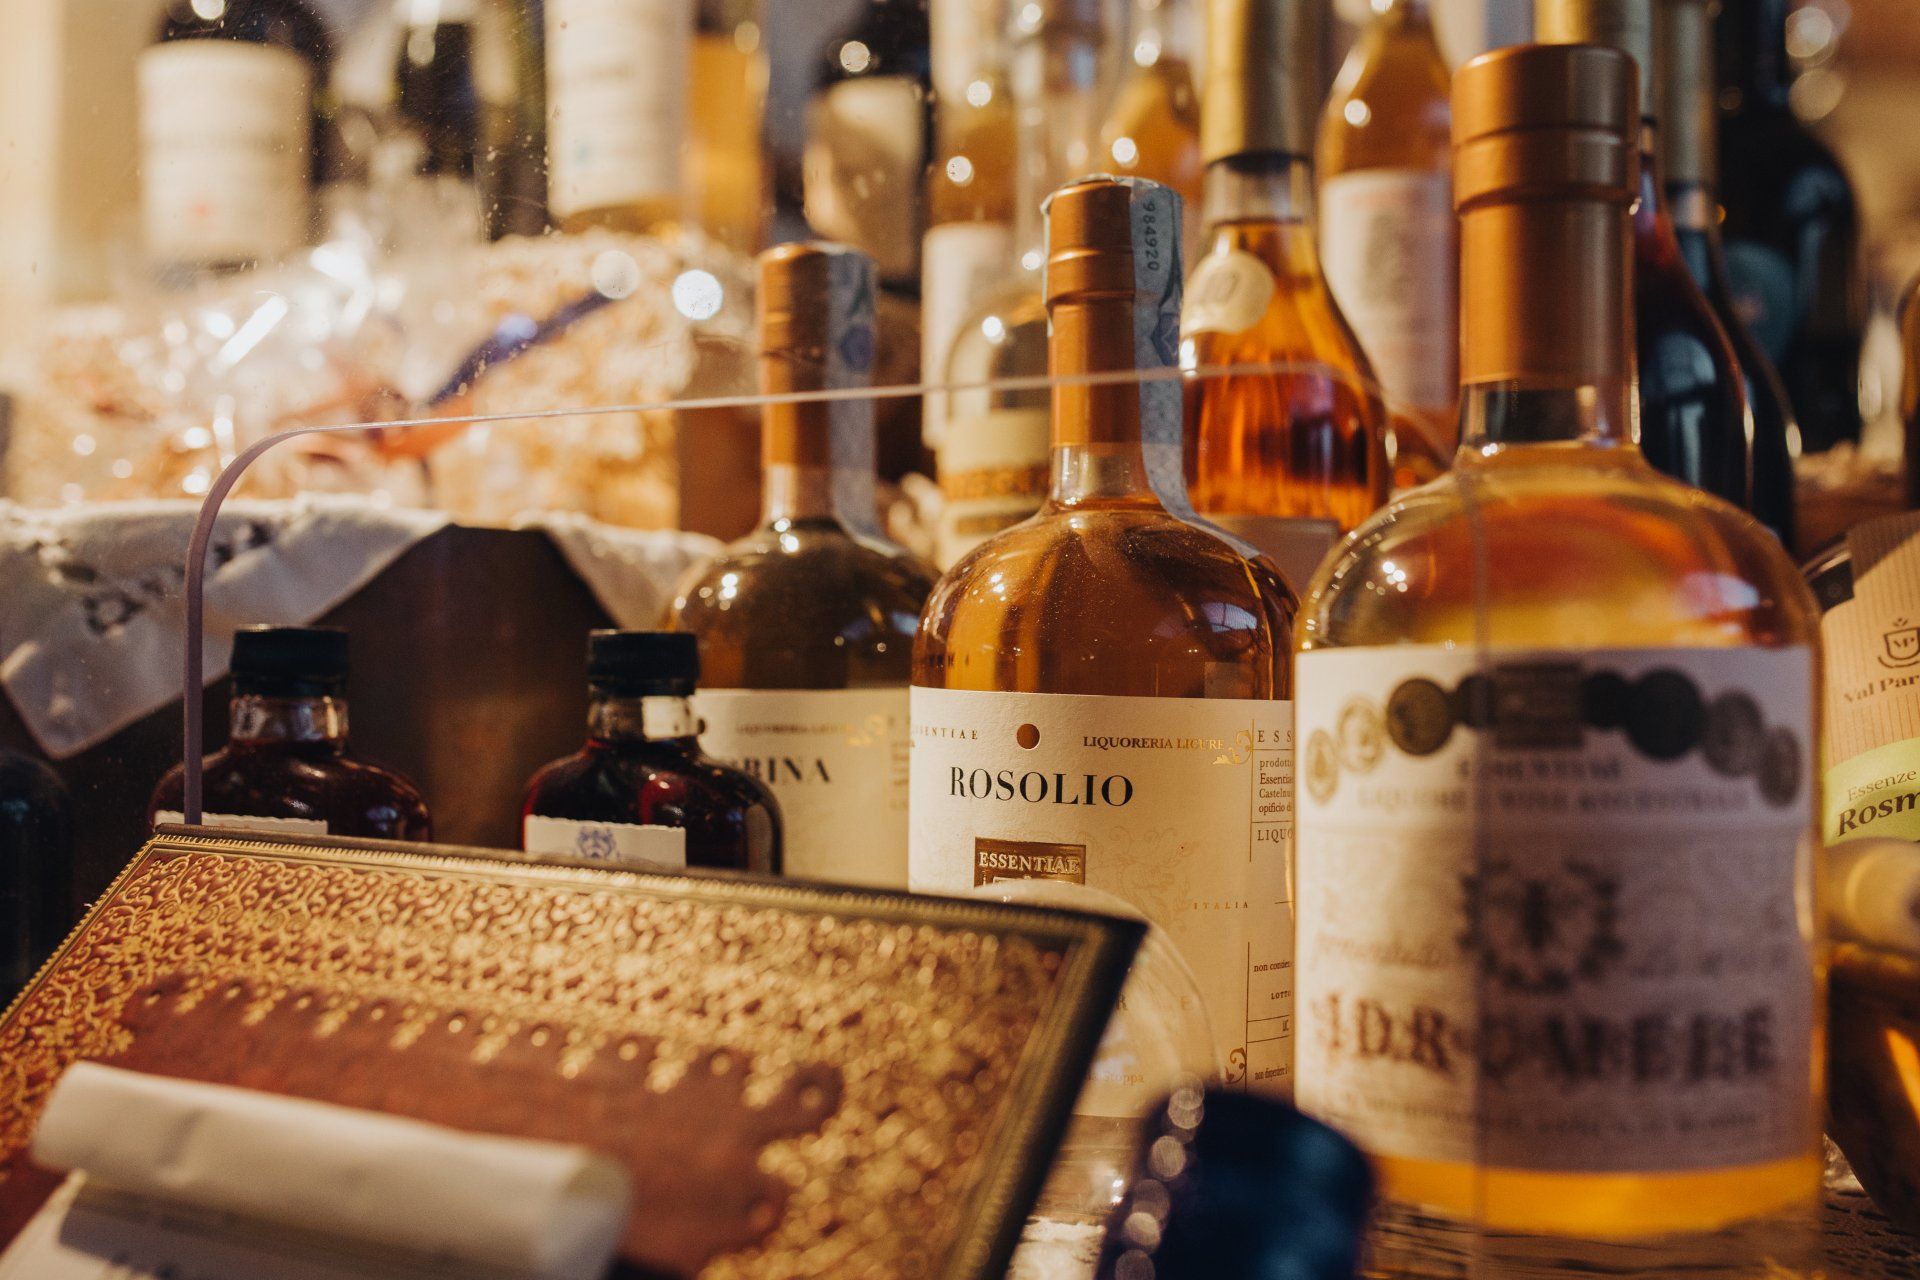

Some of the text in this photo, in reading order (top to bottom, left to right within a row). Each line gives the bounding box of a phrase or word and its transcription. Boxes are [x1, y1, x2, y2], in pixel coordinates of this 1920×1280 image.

[1142, 200, 1160, 271] 984920
[1844, 682, 1875, 702] Val
[1083, 736, 1225, 750] LIQUORERIA LIGURE
[949, 766, 1133, 807] ROSOLIO
[1847, 769, 1918, 801] Essenze
[1258, 802, 1286, 816] opificio
[979, 851, 1081, 875] ESSENTIAE
[1192, 901, 1249, 910] ITALIA
